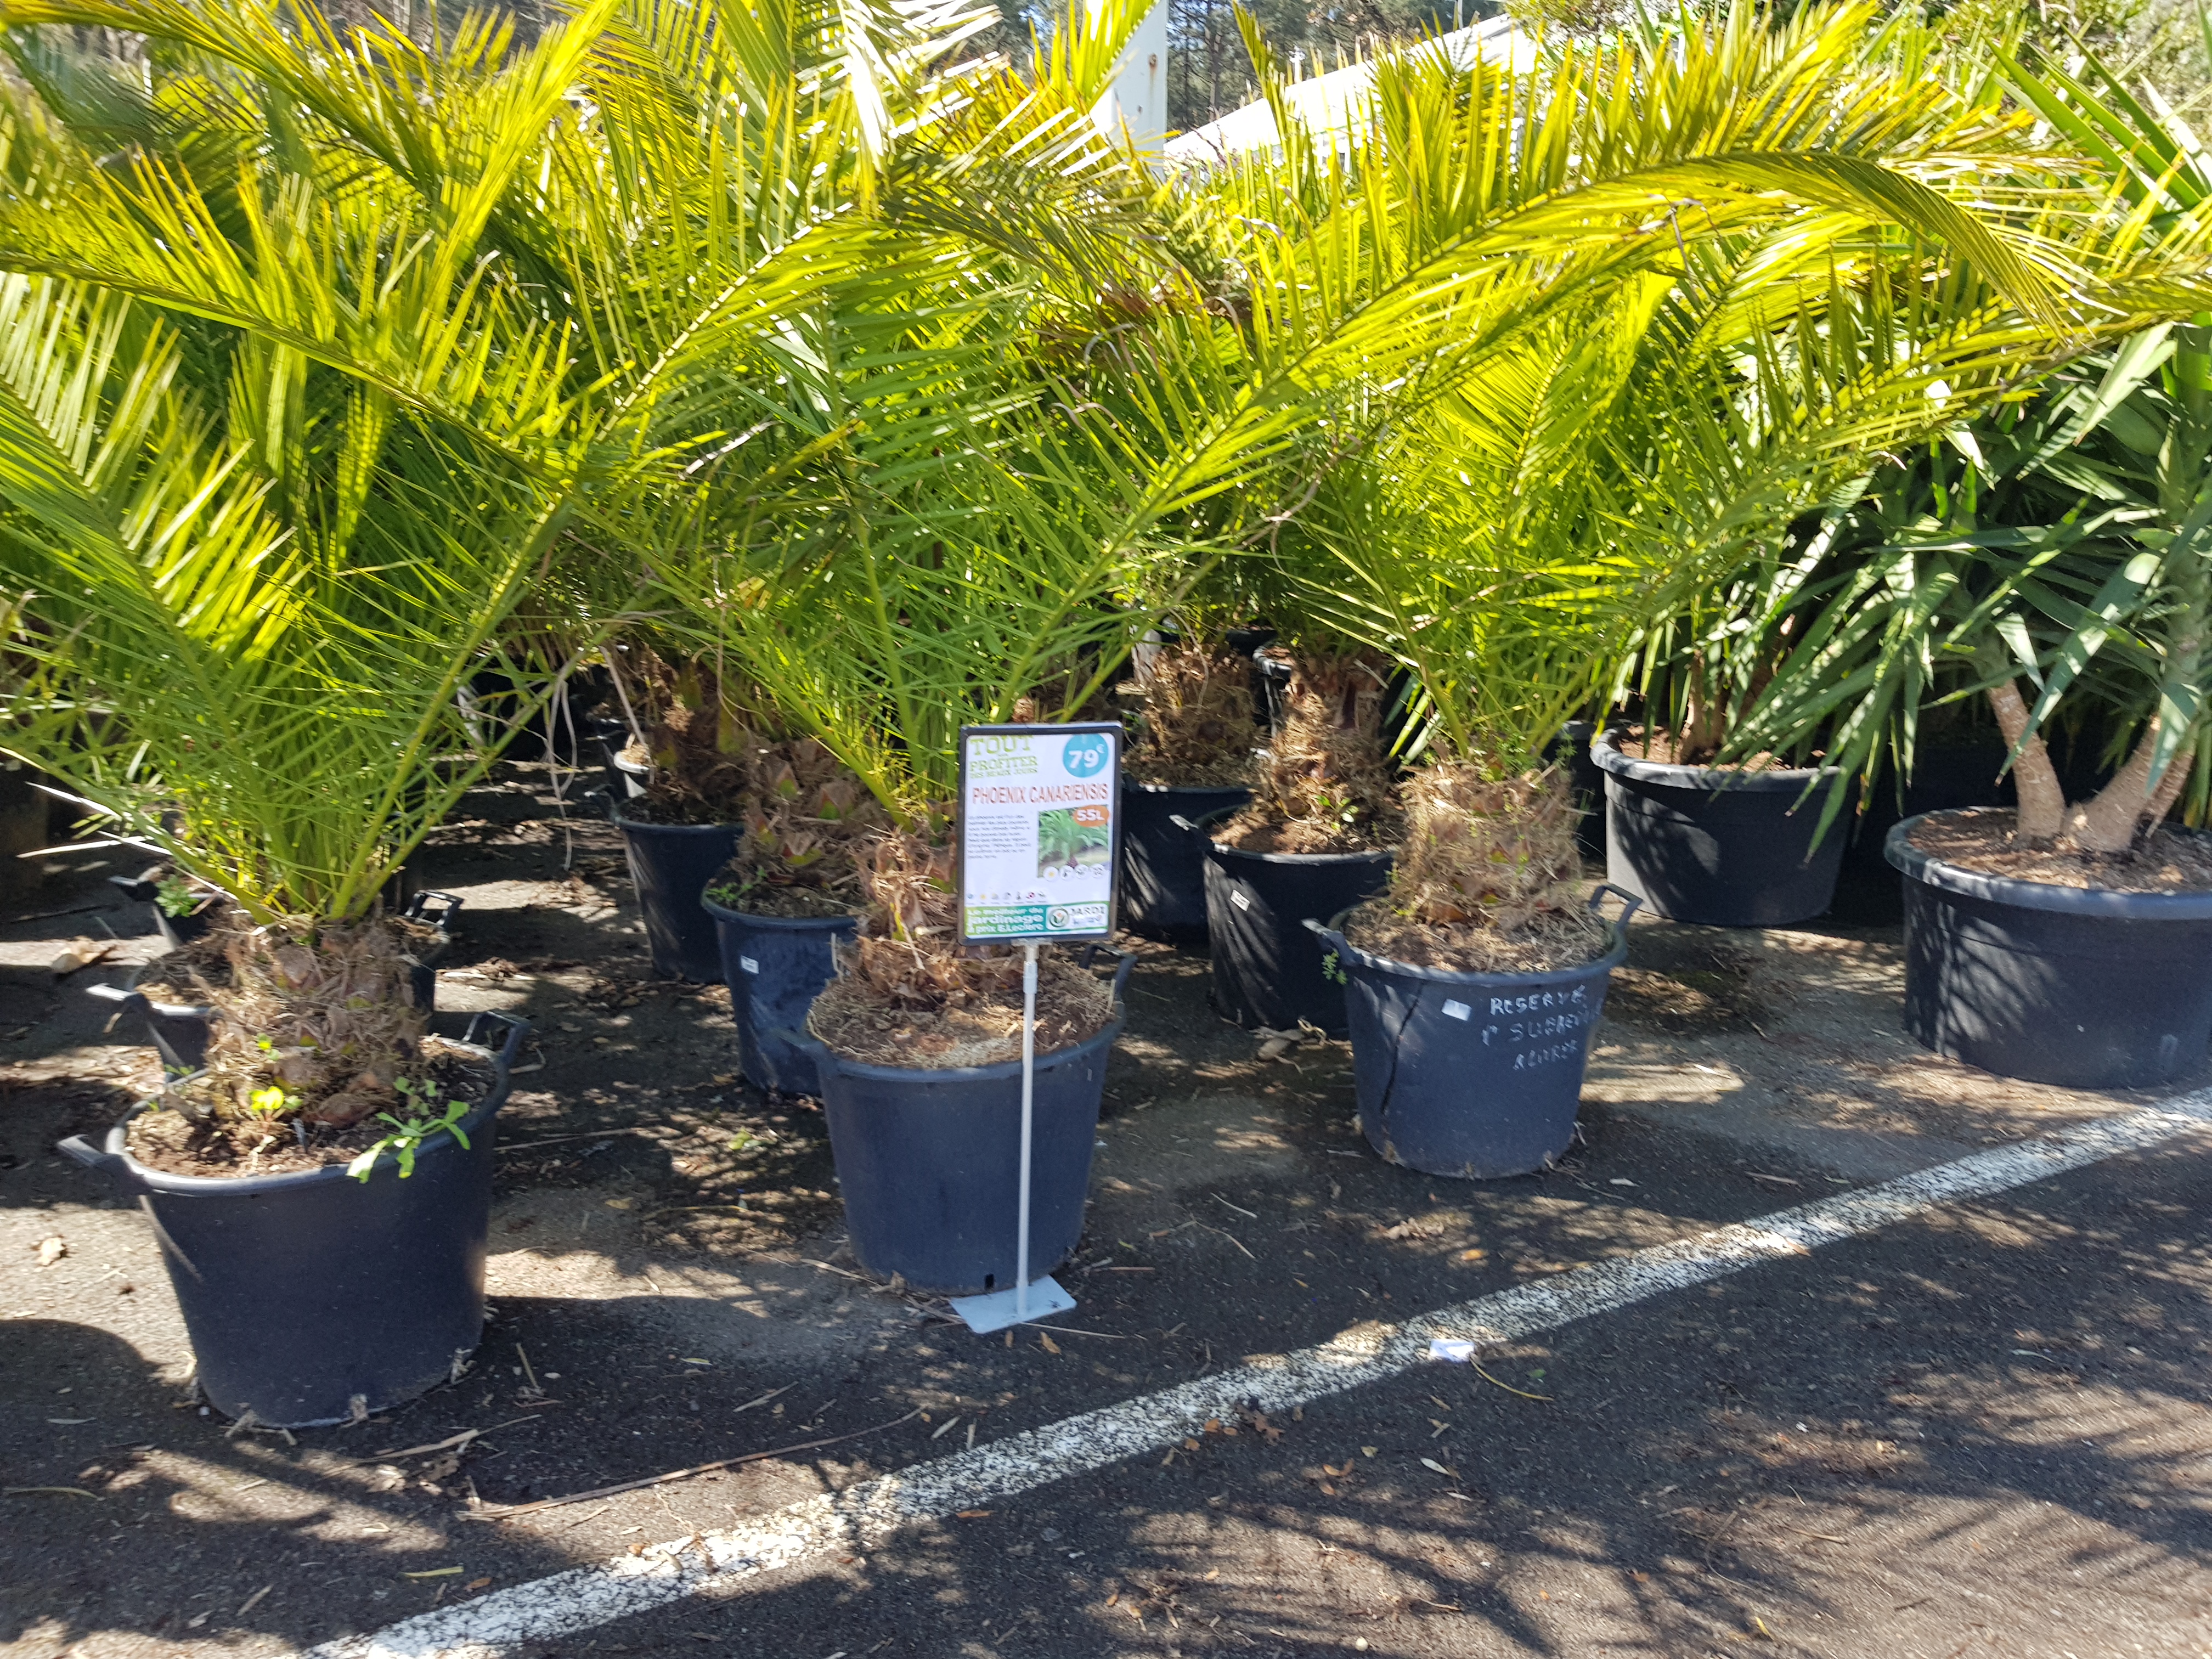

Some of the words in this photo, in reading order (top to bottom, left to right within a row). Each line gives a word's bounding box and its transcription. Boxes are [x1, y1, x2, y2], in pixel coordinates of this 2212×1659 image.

[970, 735, 1033, 755] TOUT
[969, 755, 1039, 771] PROFITER
[973, 786, 1026, 804] PHOENIX
[1030, 783, 1109, 803] CANARIENSIS
[1071, 906, 1106, 916] JARDI
[966, 913, 1045, 927] jardinage
[975, 924, 996, 934] prix
